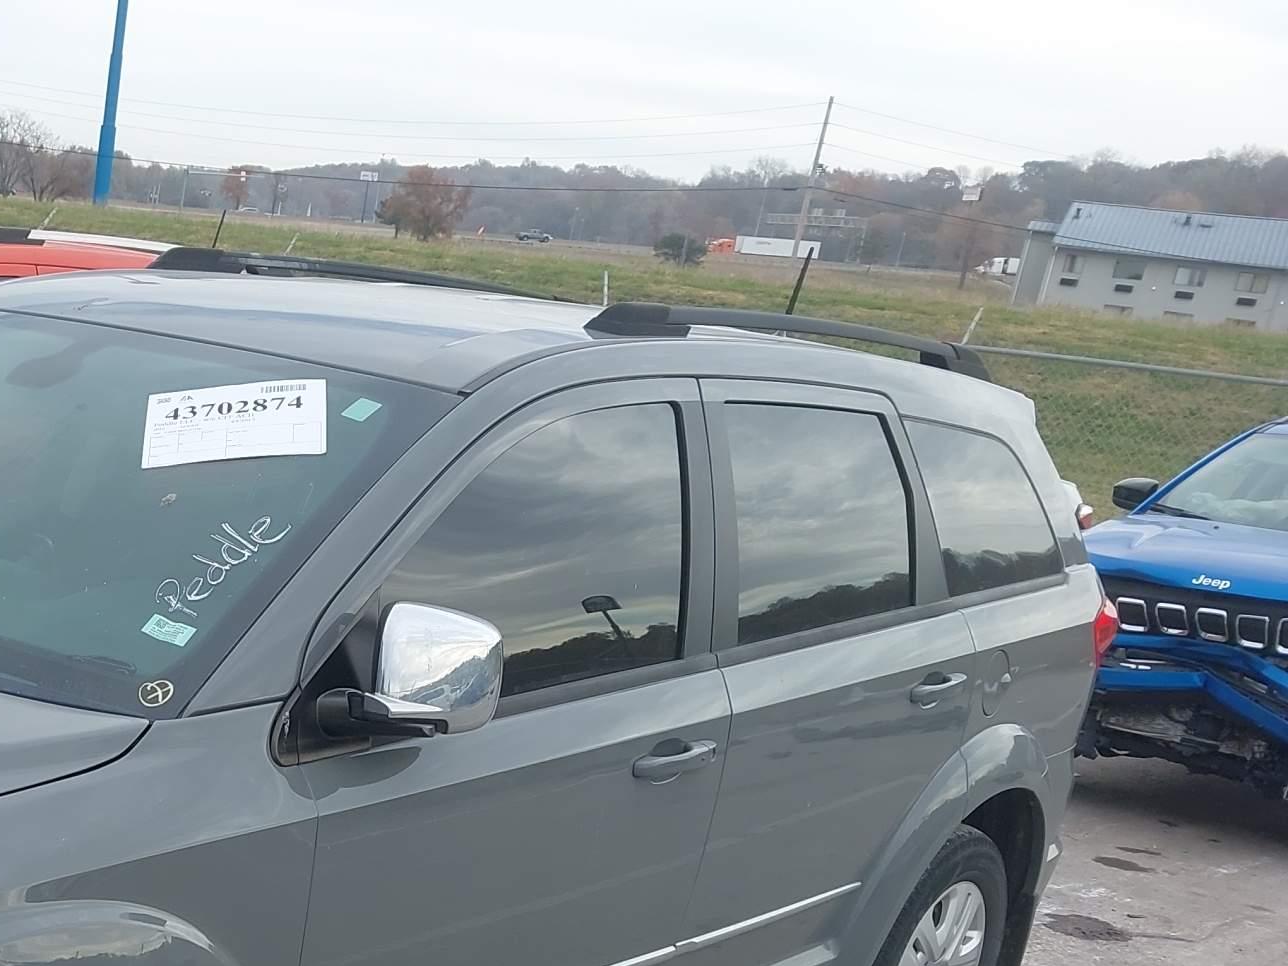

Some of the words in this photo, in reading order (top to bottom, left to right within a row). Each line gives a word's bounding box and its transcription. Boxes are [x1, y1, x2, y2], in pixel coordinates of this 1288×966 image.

[165, 395, 304, 420] 43702874
[155, 515, 292, 617] Peddle
[1192, 574, 1231, 590] Jeep
